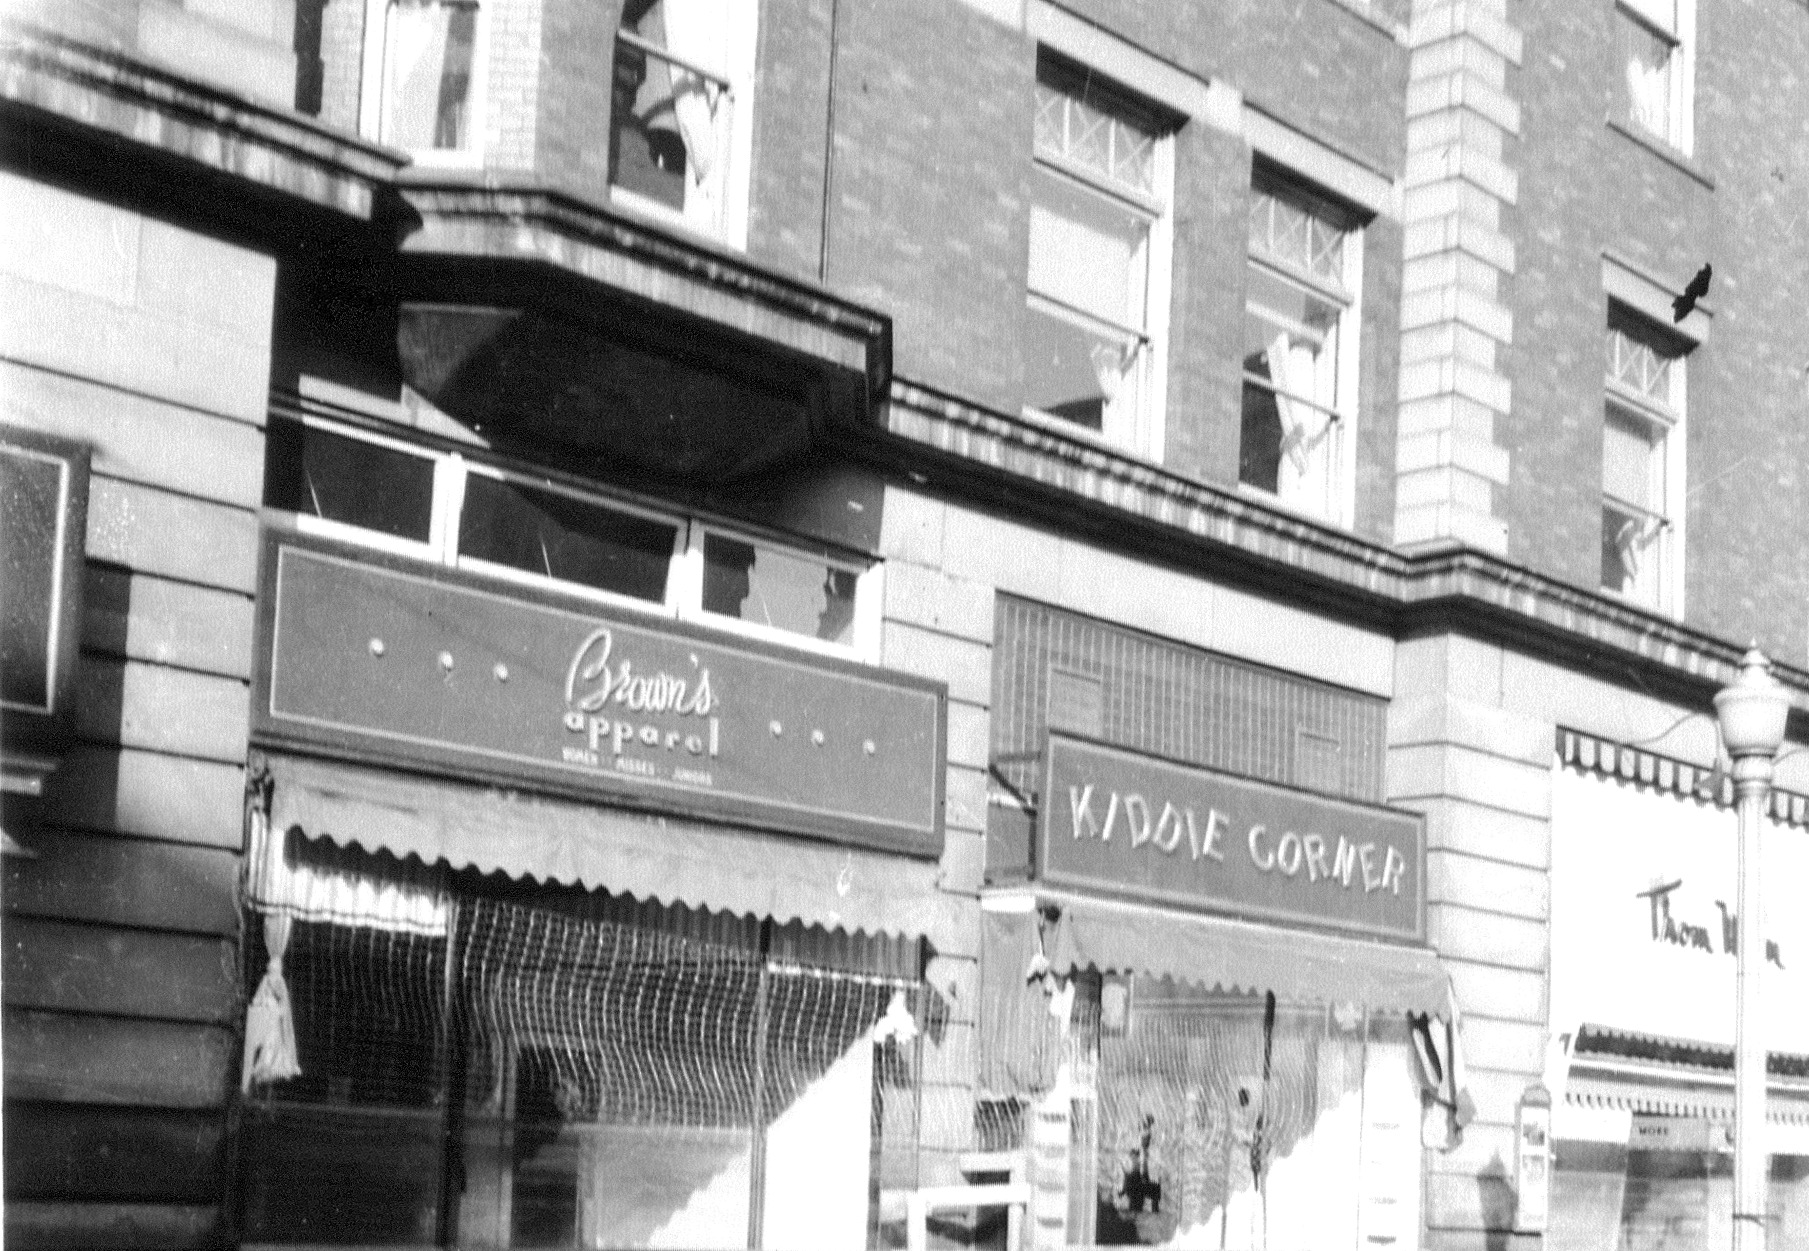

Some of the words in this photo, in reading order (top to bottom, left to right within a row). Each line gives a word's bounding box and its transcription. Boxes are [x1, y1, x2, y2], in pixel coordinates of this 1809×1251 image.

[565, 627, 719, 716] Brown's
[563, 711, 720, 756] apparel
[1069, 784, 1230, 862] KIDDIE
[1248, 822, 1405, 895] CORNER
[1635, 878, 1713, 955] Thom
